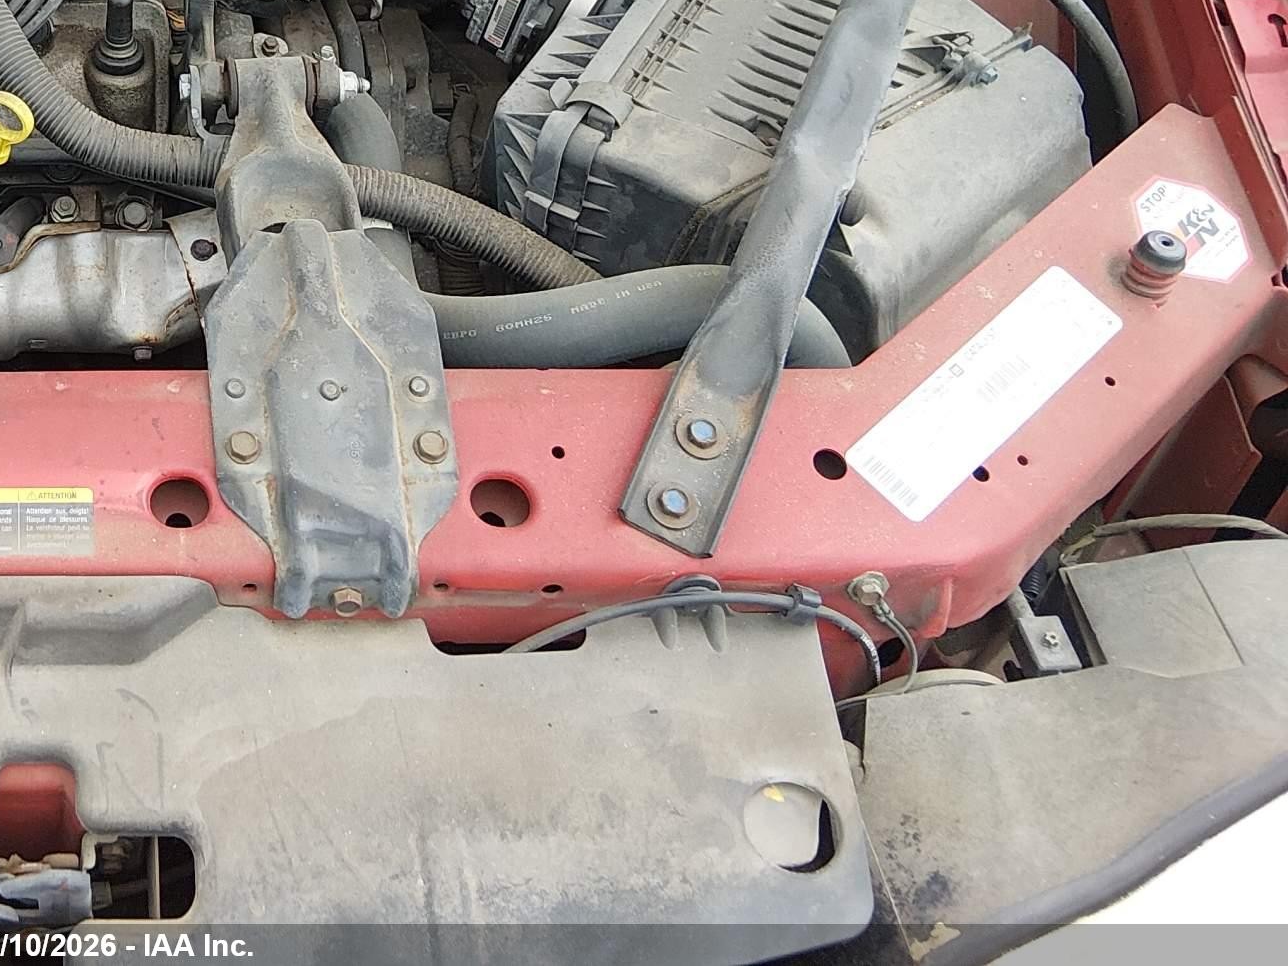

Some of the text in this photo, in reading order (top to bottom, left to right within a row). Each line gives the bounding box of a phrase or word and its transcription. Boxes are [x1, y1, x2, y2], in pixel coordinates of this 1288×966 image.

[570, 297, 606, 315] MADE
[615, 288, 632, 300] IN
[637, 281, 663, 295] USA
[38, 492, 77, 500] ATTENTION
